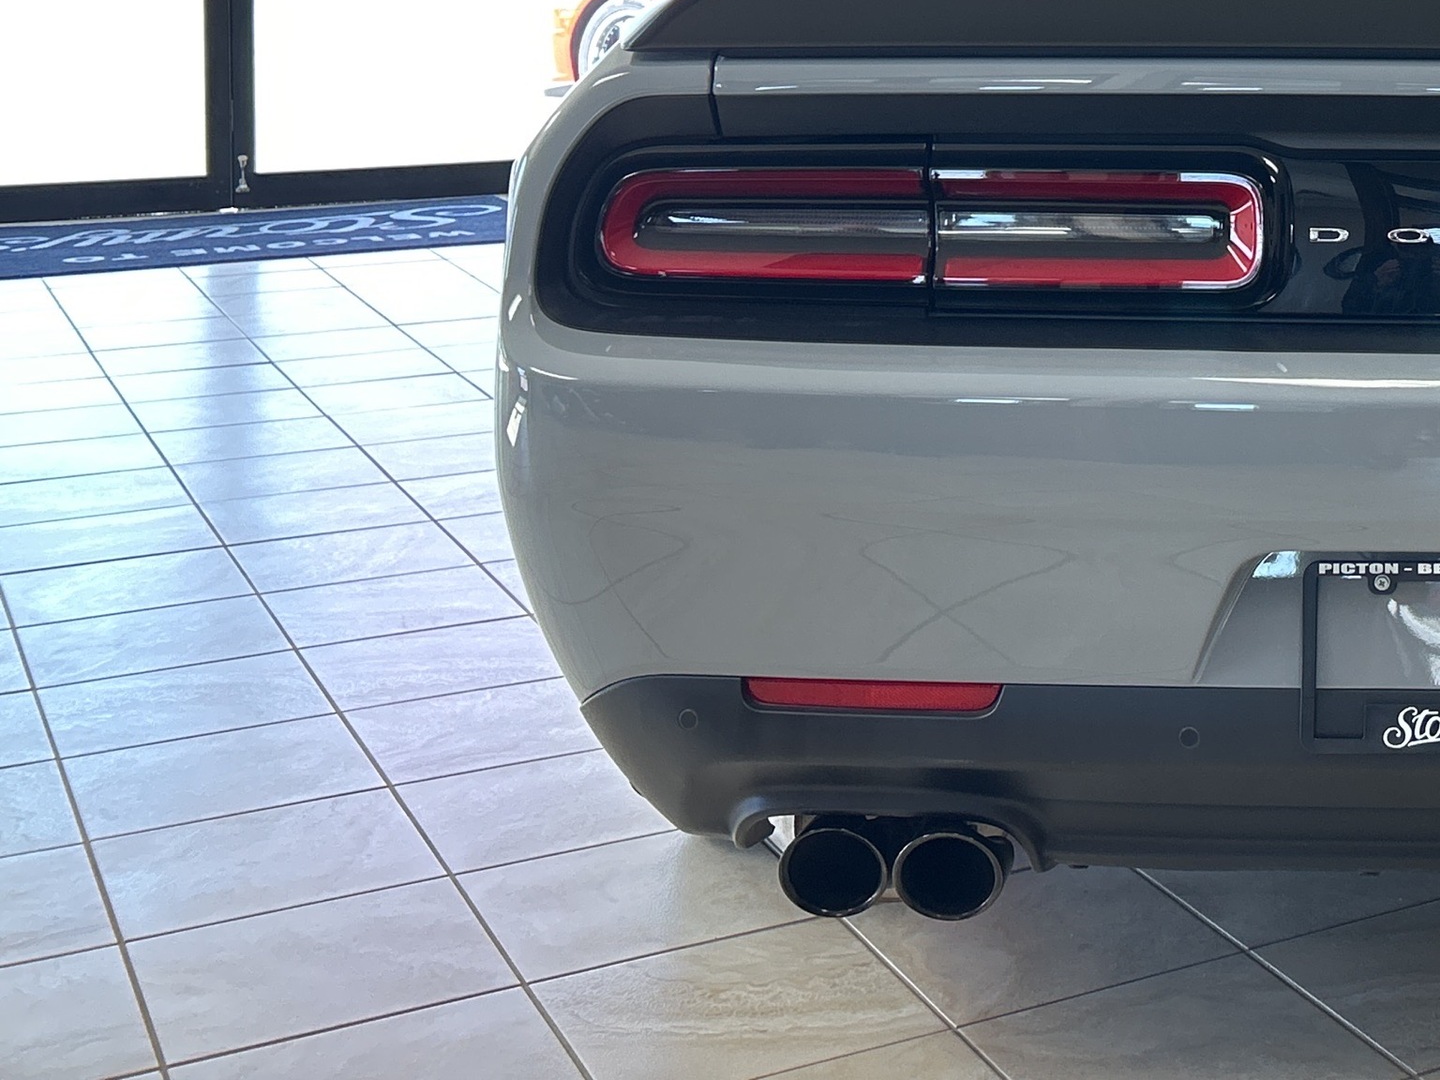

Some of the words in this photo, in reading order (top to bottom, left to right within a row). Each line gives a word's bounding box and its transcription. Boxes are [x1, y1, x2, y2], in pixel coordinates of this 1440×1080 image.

[170, 230, 476, 257] WELCOME
[62, 252, 150, 264] TO
[1318, 562, 1399, 576] PICTON
